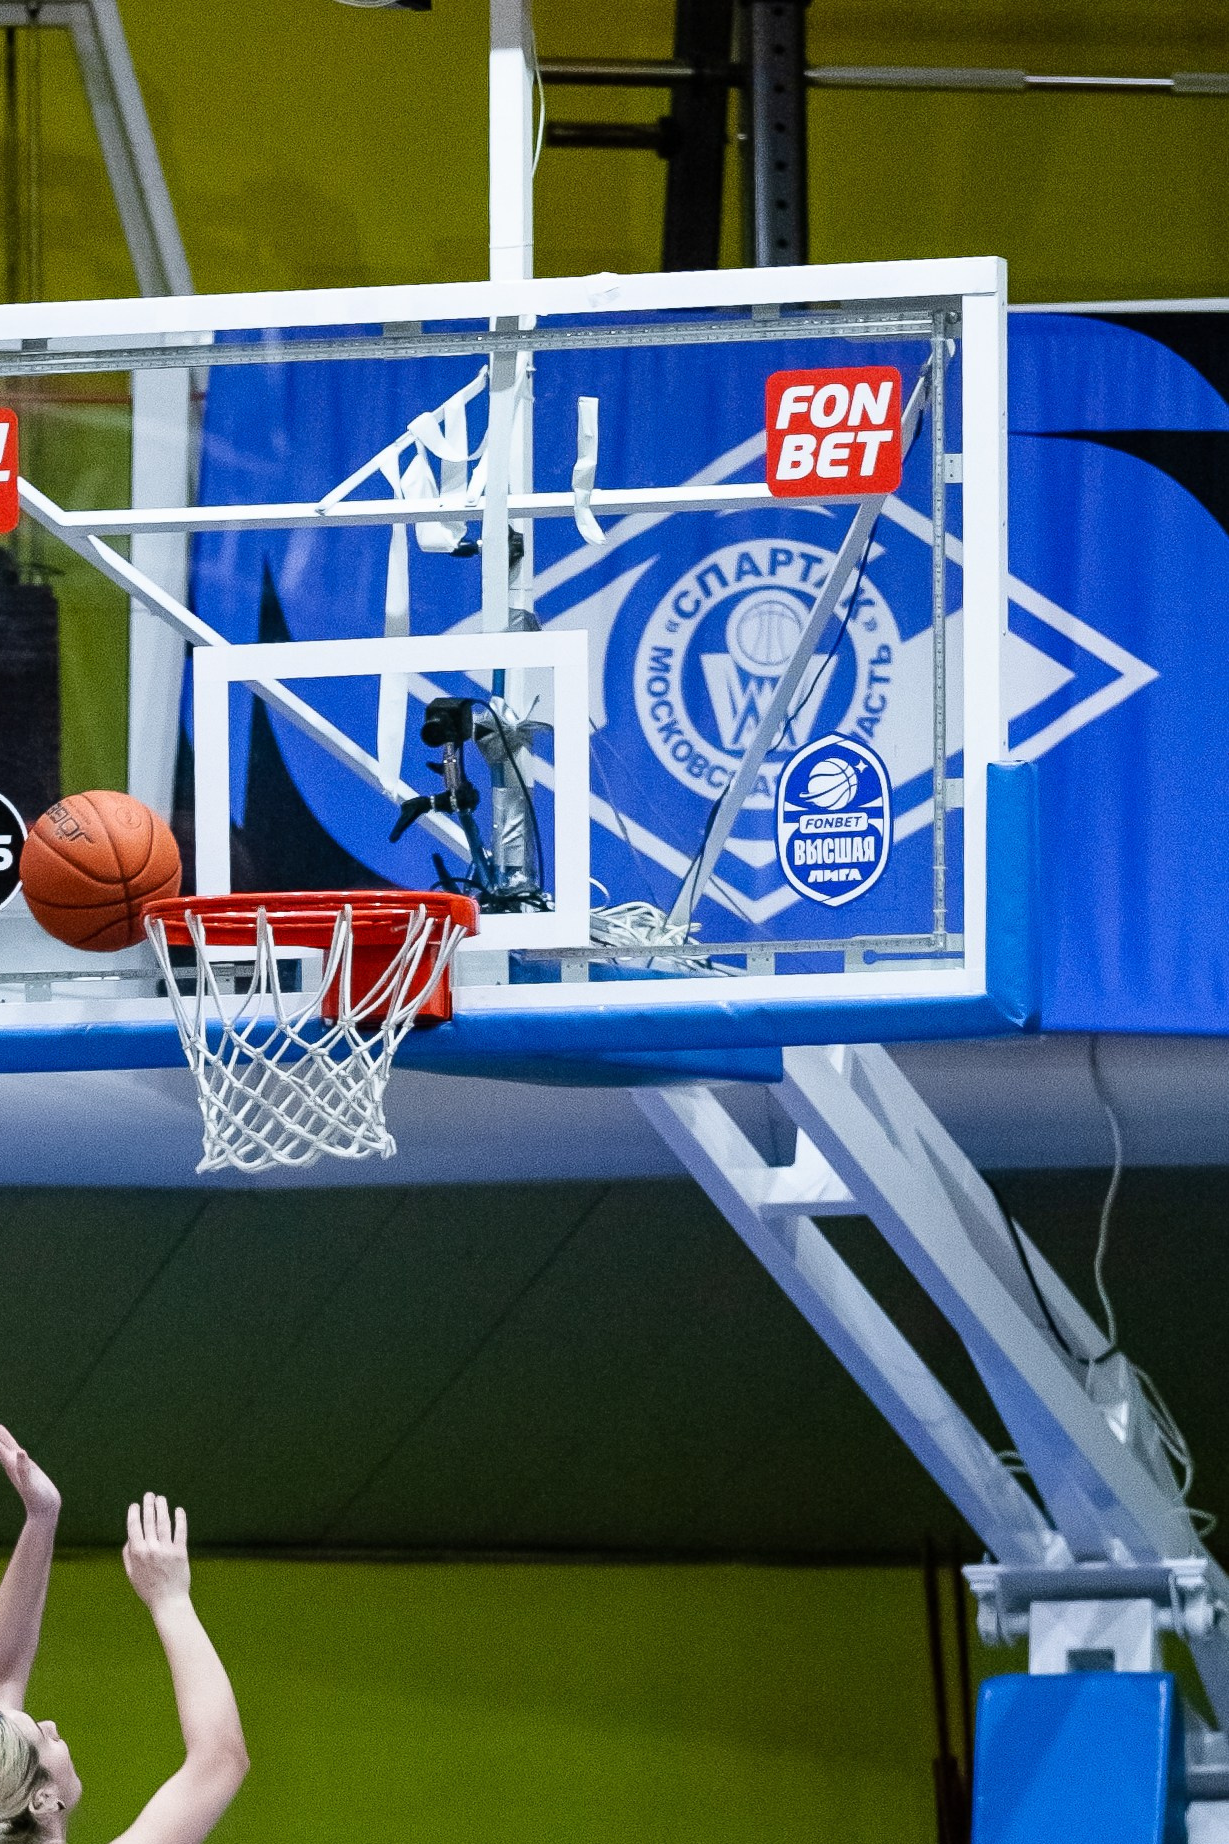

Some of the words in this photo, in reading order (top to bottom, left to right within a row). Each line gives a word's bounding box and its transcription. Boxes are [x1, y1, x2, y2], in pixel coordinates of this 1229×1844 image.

[774, 381, 894, 429] FON
[775, 432, 894, 481] BET
[805, 815, 862, 830] FONBET
[794, 836, 875, 865] ВЫСШАЯ
[808, 868, 863, 883] ЛИГА
